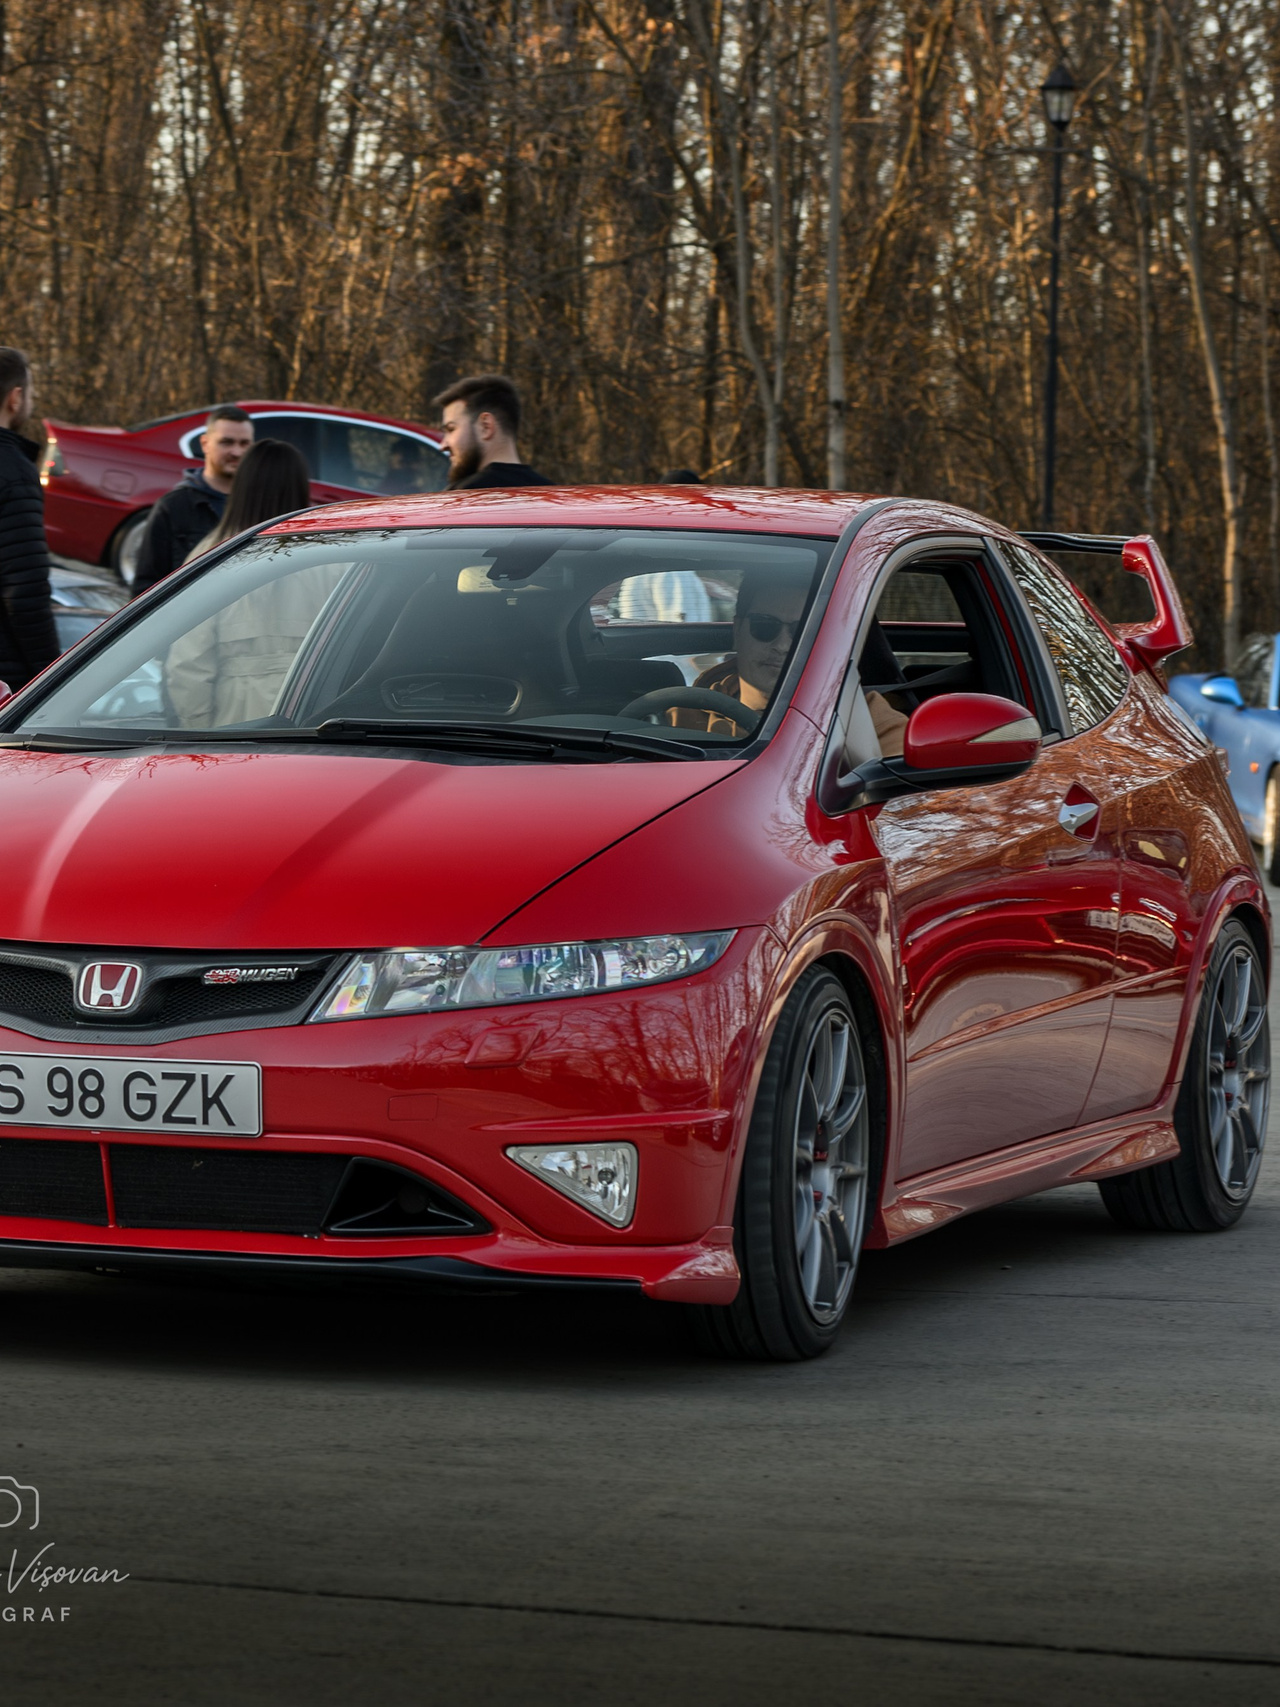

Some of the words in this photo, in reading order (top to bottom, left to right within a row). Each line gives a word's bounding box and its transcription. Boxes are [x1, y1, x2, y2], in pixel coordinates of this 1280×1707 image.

[240, 967, 298, 981] MUGEN
[47, 1066, 106, 1119] 98
[123, 1070, 236, 1126] GZK
